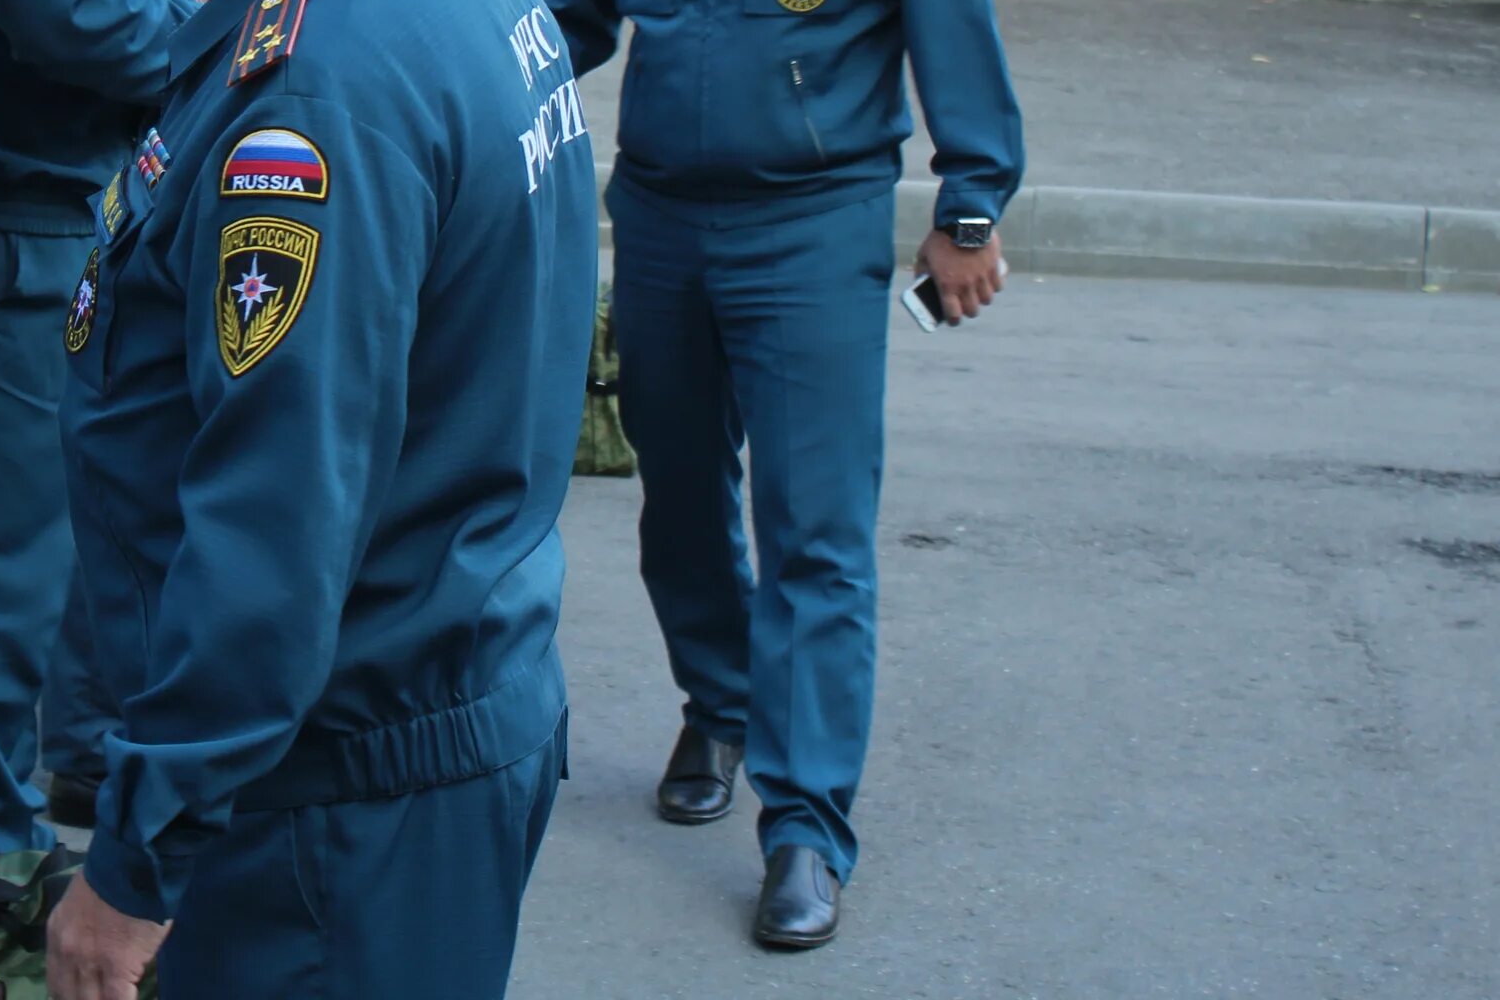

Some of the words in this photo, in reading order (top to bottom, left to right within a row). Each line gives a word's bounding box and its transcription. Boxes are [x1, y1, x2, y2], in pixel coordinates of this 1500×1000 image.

[509, 4, 560, 92] МЧС
[232, 174, 304, 192] RUSSIA
[249, 227, 306, 257] РОССИИ
